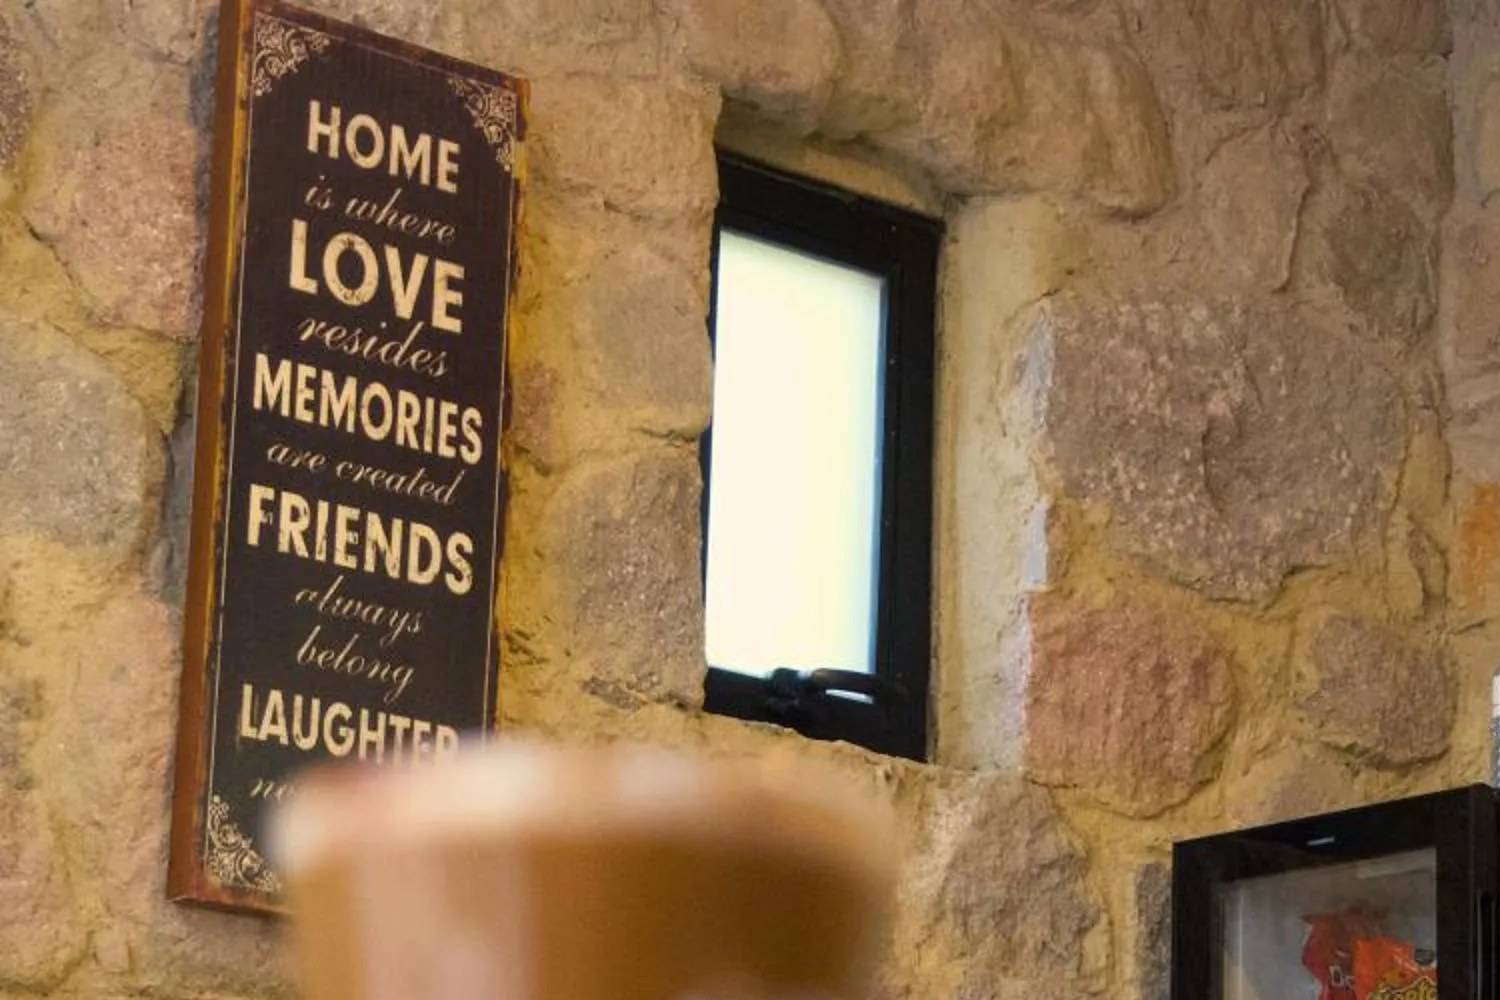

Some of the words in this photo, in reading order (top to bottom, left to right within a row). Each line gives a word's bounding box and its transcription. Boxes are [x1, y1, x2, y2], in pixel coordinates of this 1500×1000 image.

[307, 100, 461, 193] HOME
[304, 175, 331, 210] is
[346, 188, 457, 245] where
[288, 219, 465, 333] LOVE
[298, 317, 449, 379] resides
[252, 352, 483, 465] MEMORIES
[267, 442, 327, 473] are
[335, 460, 465, 506] created
[247, 483, 474, 596] FRIENDS
[295, 574, 423, 648] always
[296, 624, 416, 704] belong
